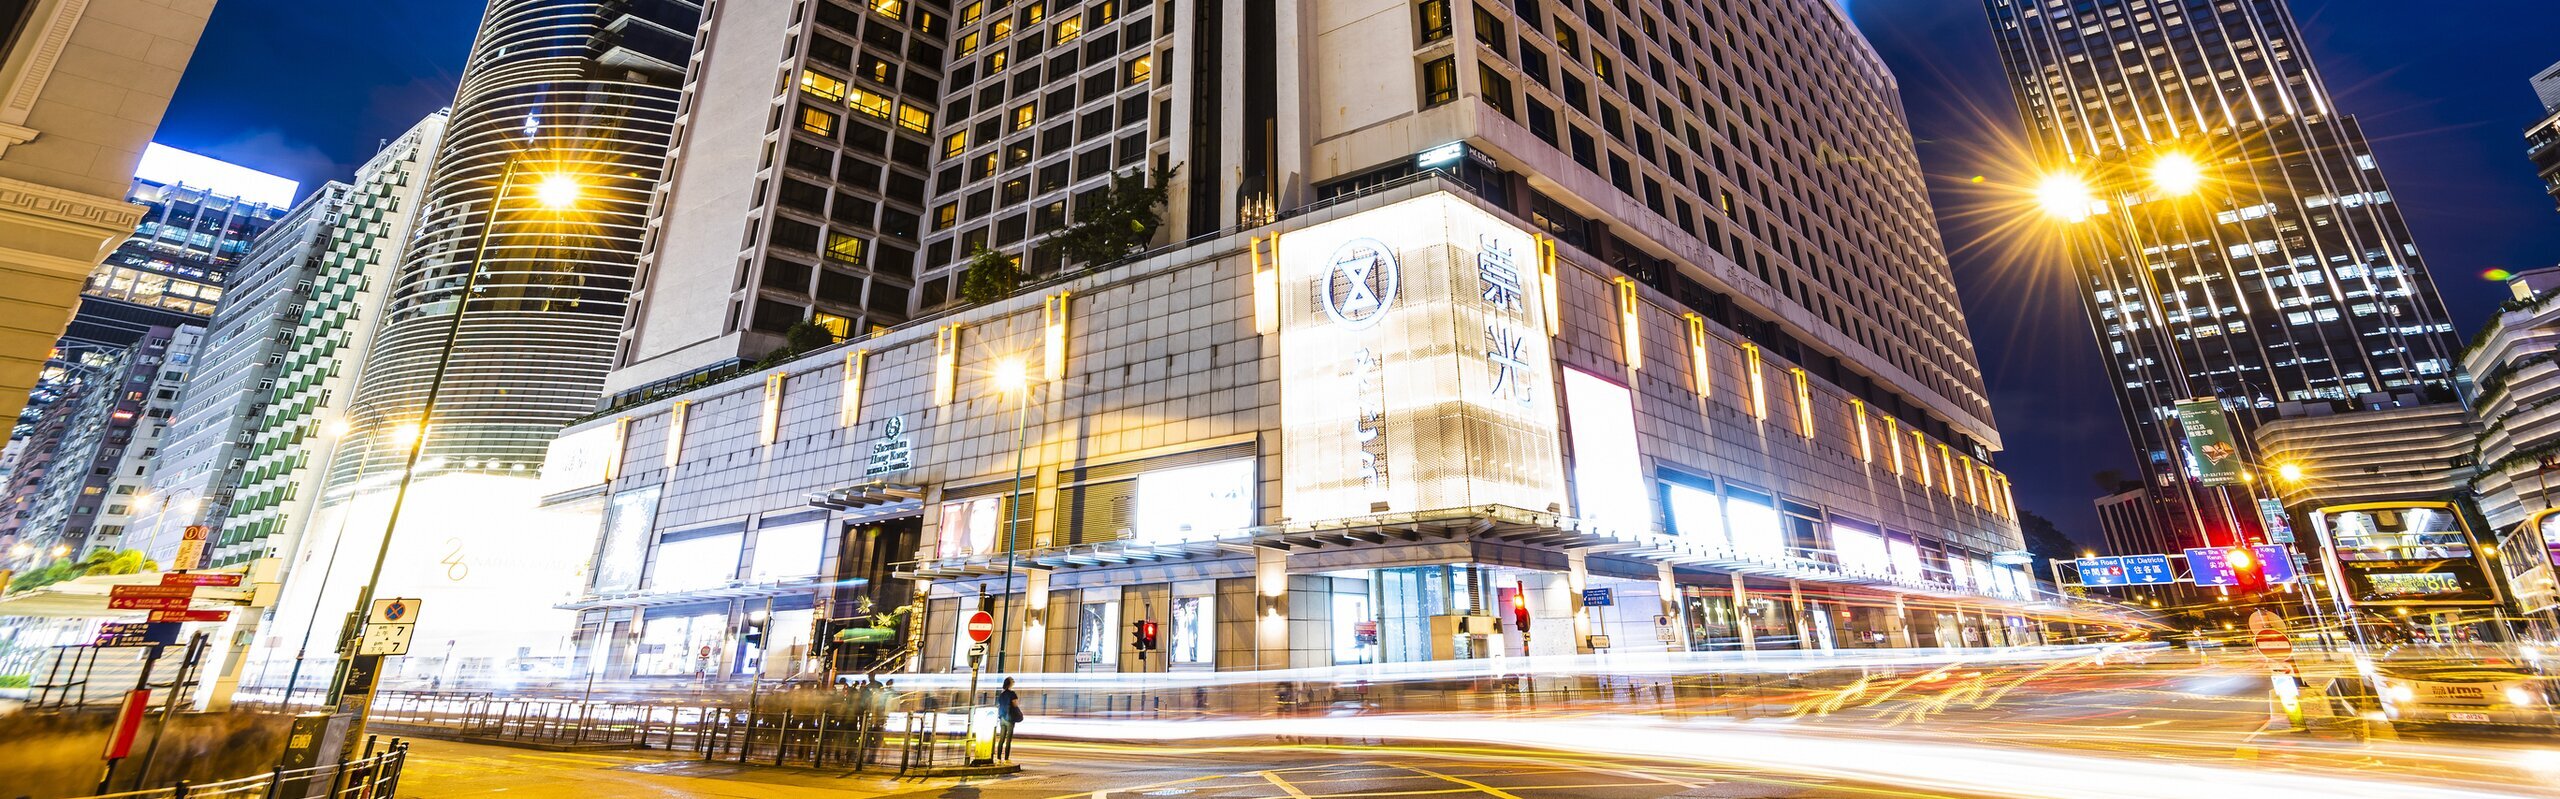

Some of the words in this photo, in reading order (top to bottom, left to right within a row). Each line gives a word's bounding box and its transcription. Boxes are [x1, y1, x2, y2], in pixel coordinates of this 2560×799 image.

[1478, 234, 1533, 408] 崇光
[873, 440, 907, 454] Sheraton
[870, 455, 889, 465] Hong
[890, 451, 908, 461] Kong
[2082, 568, 2110, 576] 中間道
[2133, 565, 2162, 574] 往各區
[397, 626, 405, 636] 7
[392, 642, 400, 652] 7
